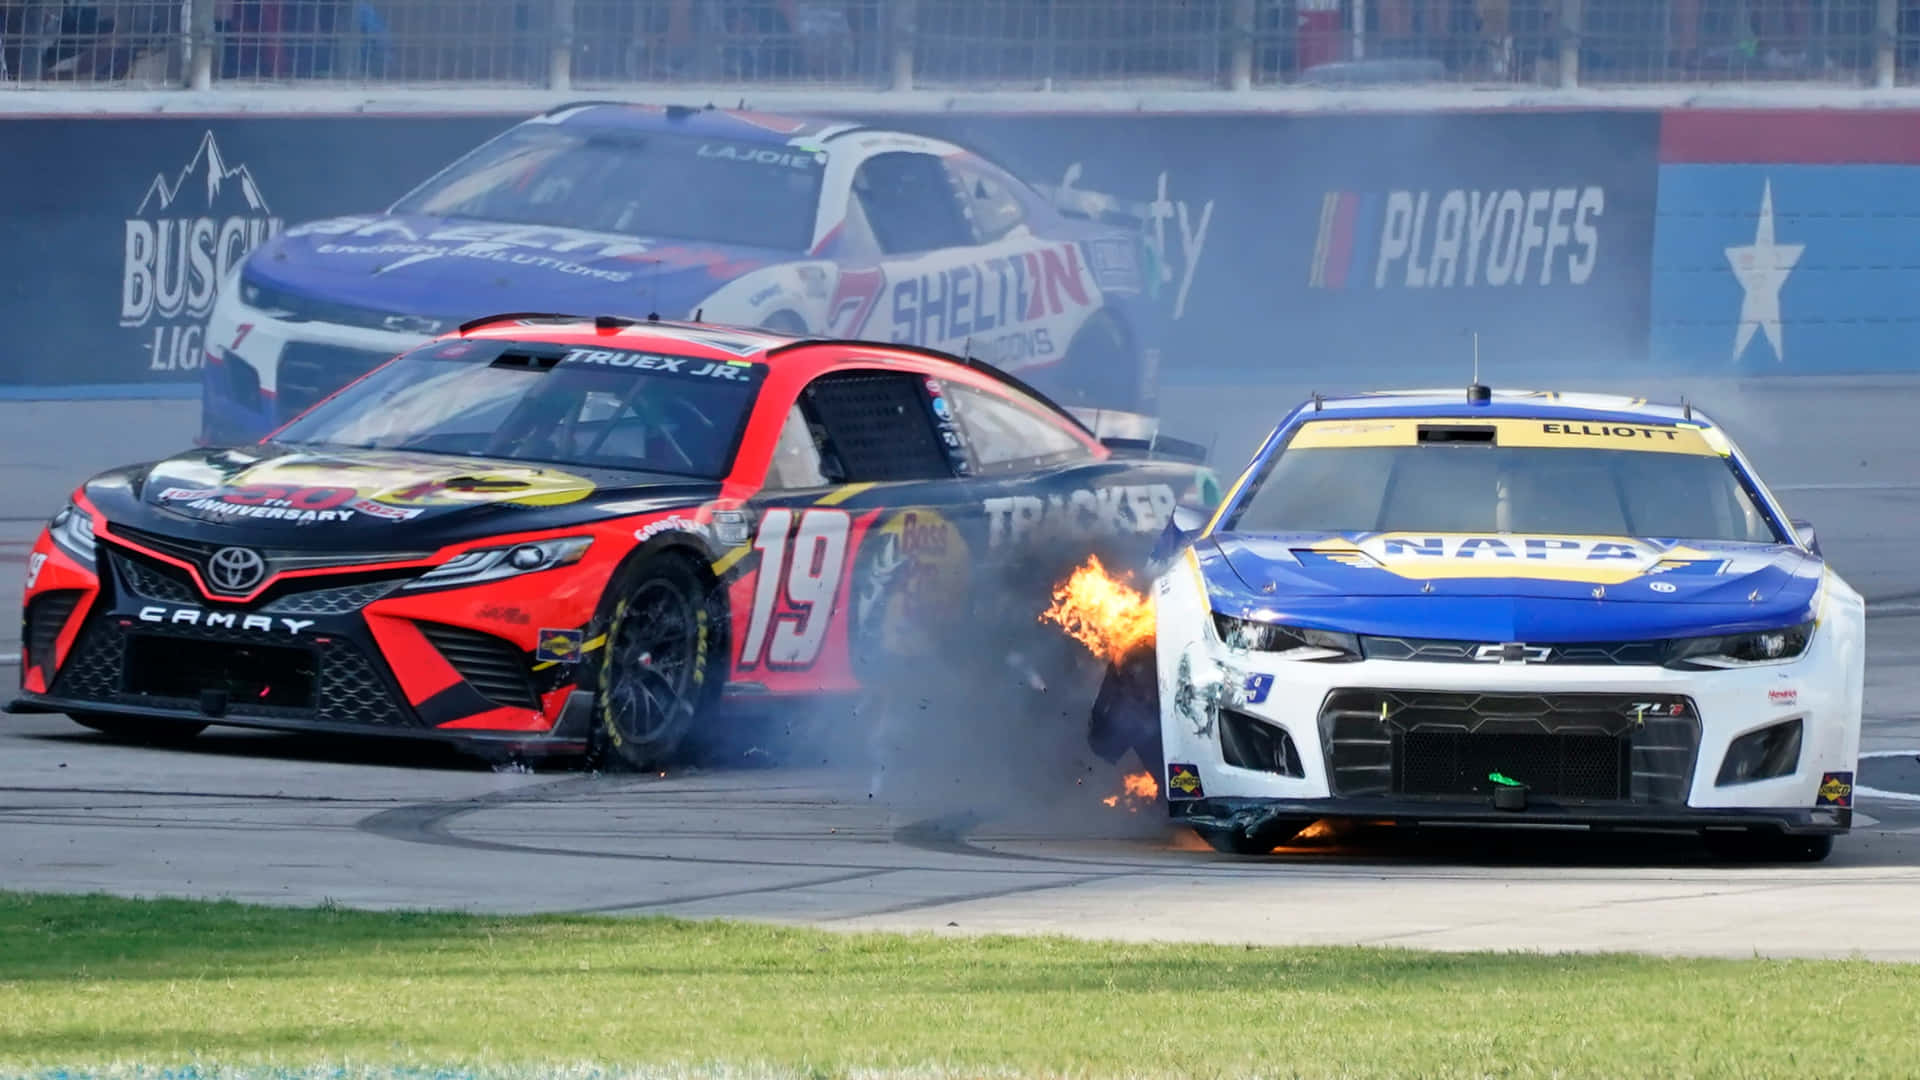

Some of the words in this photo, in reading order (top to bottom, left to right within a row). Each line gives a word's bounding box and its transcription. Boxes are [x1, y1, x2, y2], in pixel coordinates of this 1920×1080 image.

[696, 144, 812, 169] LAJOIE
[1374, 186, 1605, 288] PLAYOFFS
[152, 325, 209, 371] LIG
[567, 348, 687, 373] TRUEX
[689, 363, 750, 381] JR.
[1543, 423, 1679, 440] ELLIOTT
[187, 499, 355, 521] ANNIVERSARY
[1383, 538, 1639, 560] NAPA
[737, 508, 850, 670] 19
[139, 606, 315, 634] CAMRY
[1820, 782, 1851, 796] SUNOCO
